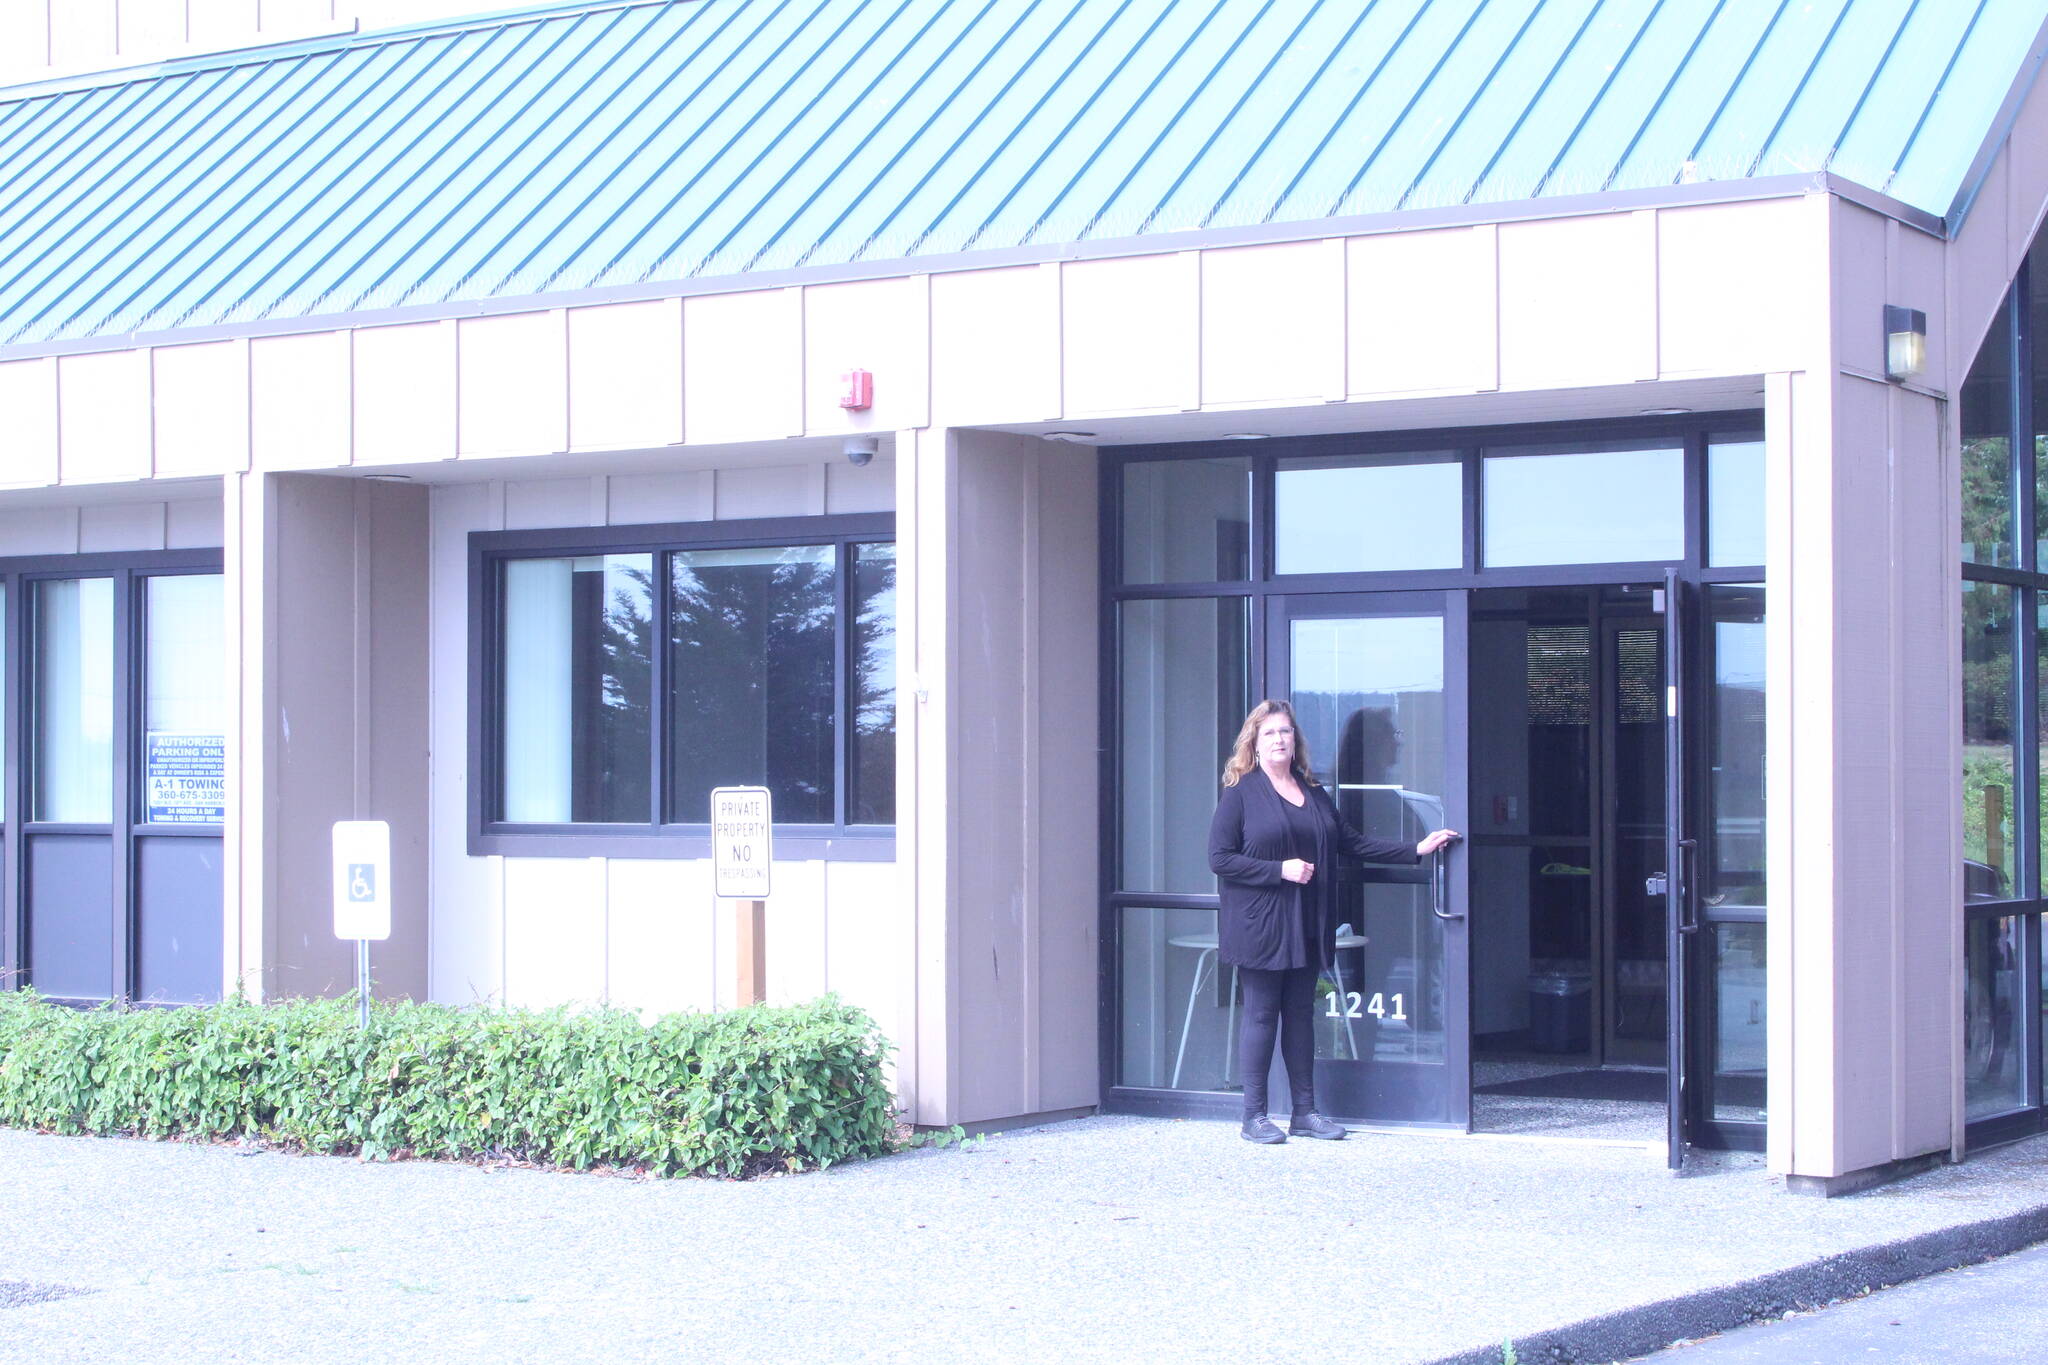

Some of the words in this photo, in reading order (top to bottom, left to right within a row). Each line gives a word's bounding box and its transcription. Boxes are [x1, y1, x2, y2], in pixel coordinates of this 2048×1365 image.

[152, 748, 200, 756] PARKING
[202, 748, 225, 756] ONL
[155, 779, 173, 789] A-1
[721, 801, 760, 816] PRIVATE
[717, 822, 765, 837] PROPERTY
[733, 844, 751, 862] NO
[720, 867, 766, 880] TRESPASSING
[1325, 991, 1407, 1020] 1241
